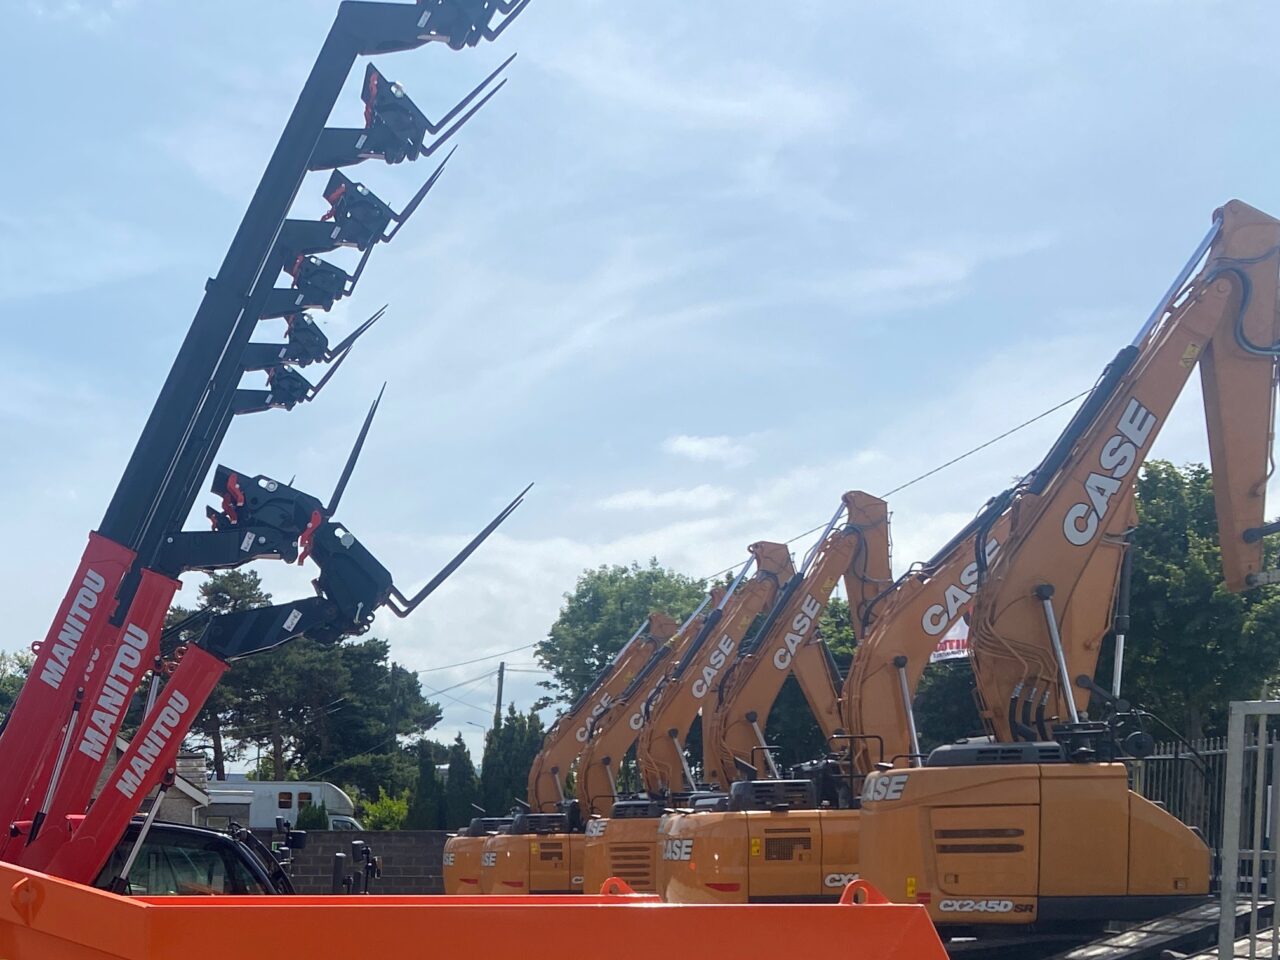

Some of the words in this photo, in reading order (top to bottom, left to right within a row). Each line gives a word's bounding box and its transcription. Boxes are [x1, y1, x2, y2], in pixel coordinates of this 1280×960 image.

[1063, 397, 1158, 547] CASE
[40, 568, 105, 690] MANITOU
[692, 634, 735, 698] CASE
[773, 593, 821, 670] CASE
[78, 623, 149, 763] MANITOU
[115, 690, 190, 800] MANITOU
[861, 775, 909, 801] ASE
[663, 838, 694, 861] ASE
[939, 899, 1013, 913] CX245D
